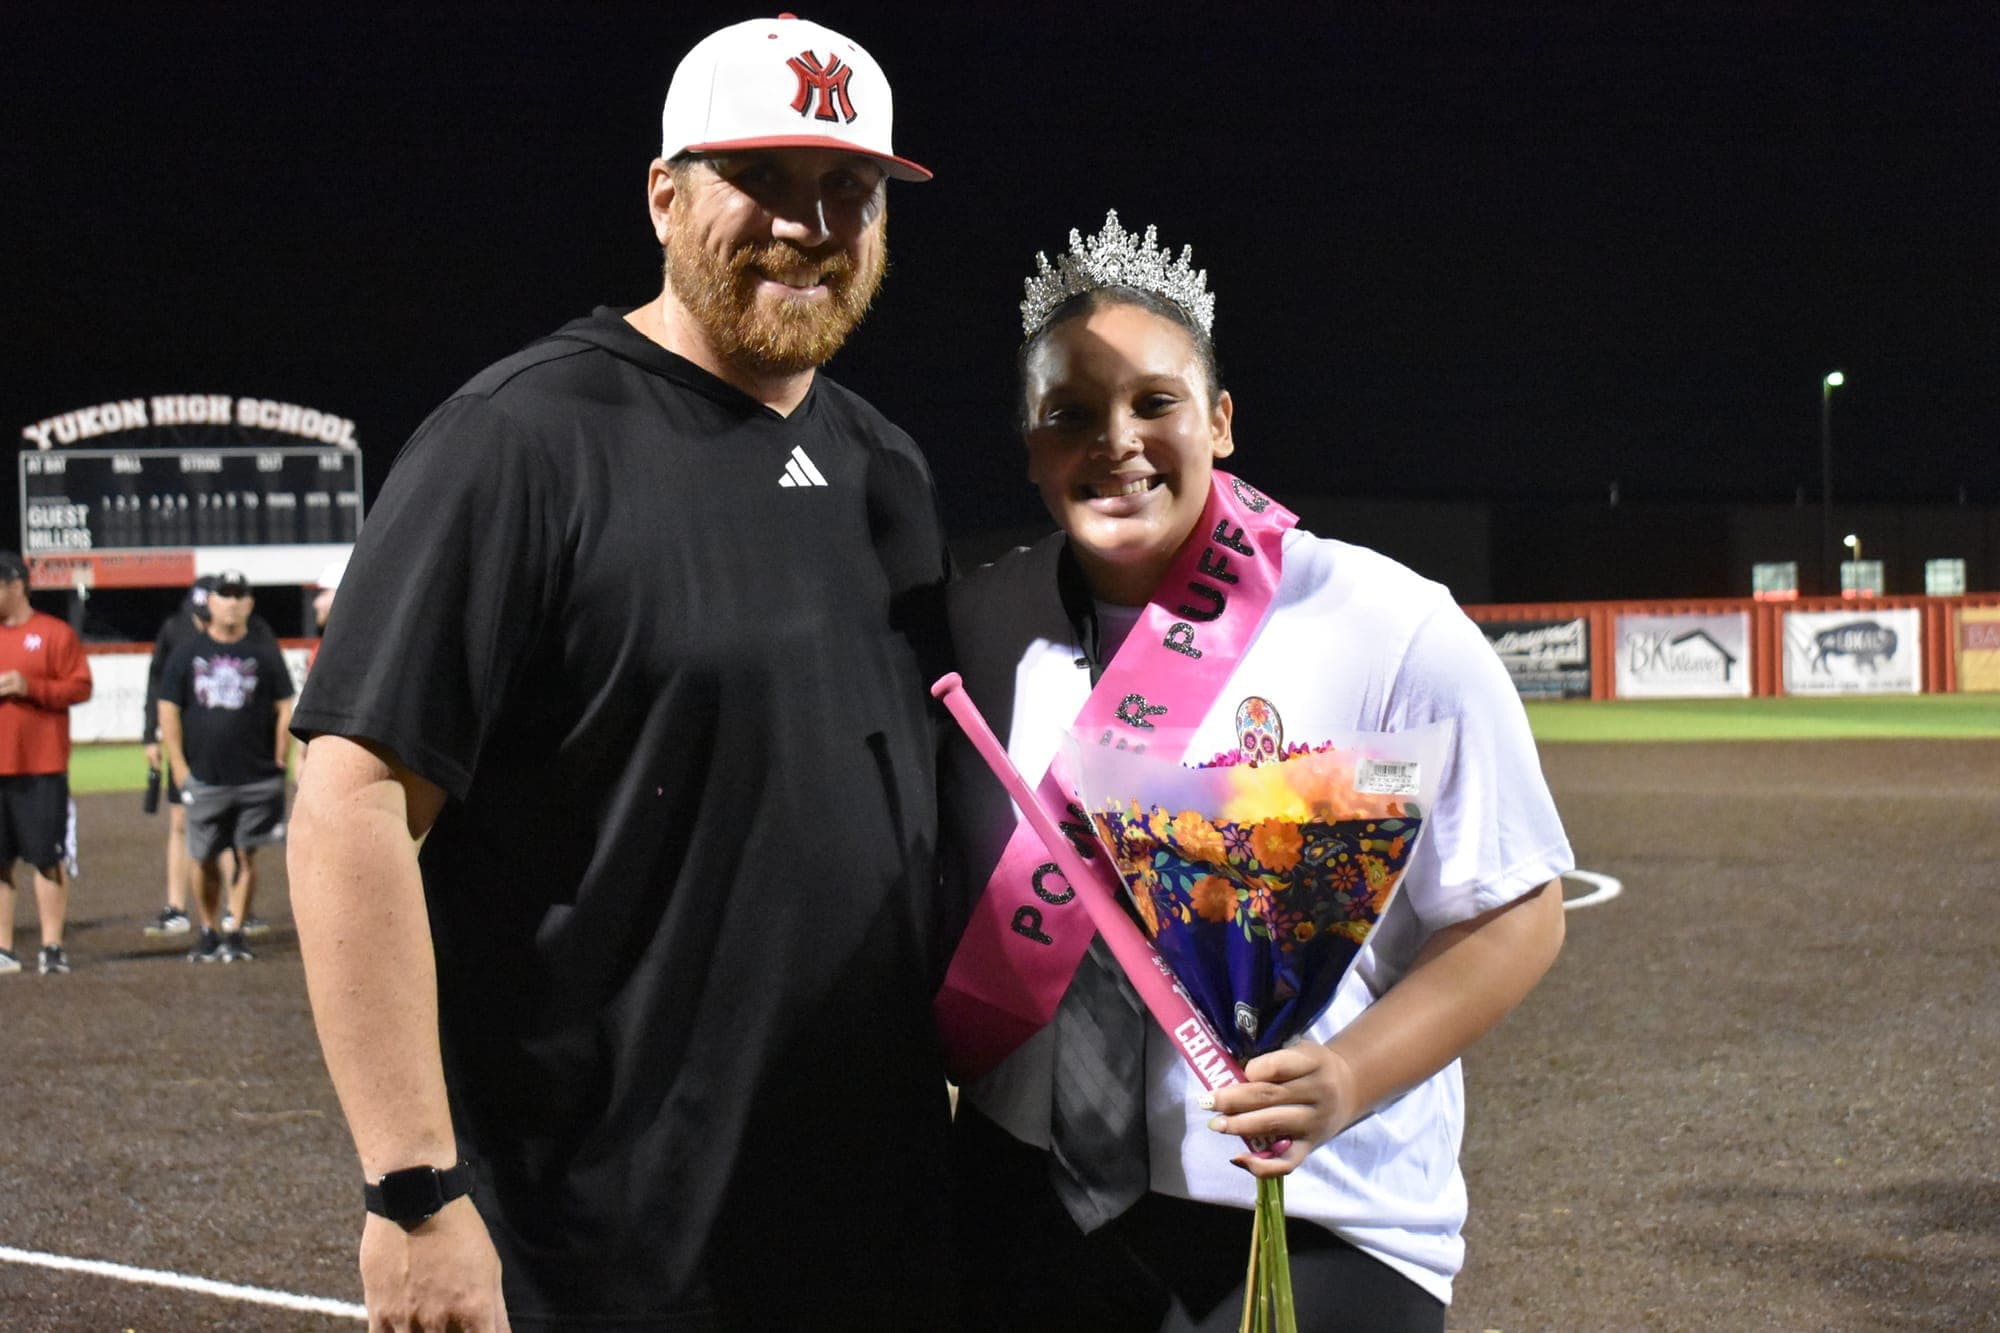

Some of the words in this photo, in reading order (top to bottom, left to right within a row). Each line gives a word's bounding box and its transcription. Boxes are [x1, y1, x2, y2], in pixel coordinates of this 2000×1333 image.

[23, 398, 149, 451] YUKON
[151, 395, 232, 426] HIGH
[237, 398, 358, 449] SCHOOL
[112, 454, 143, 474] BALL
[256, 452, 284, 472] OUT
[28, 504, 89, 528] GUEST
[29, 529, 92, 549] MILLERS
[1163, 519, 1255, 660] PUFF
[1627, 629, 1672, 674] BK
[1175, 1017, 1239, 1093] CHAM
